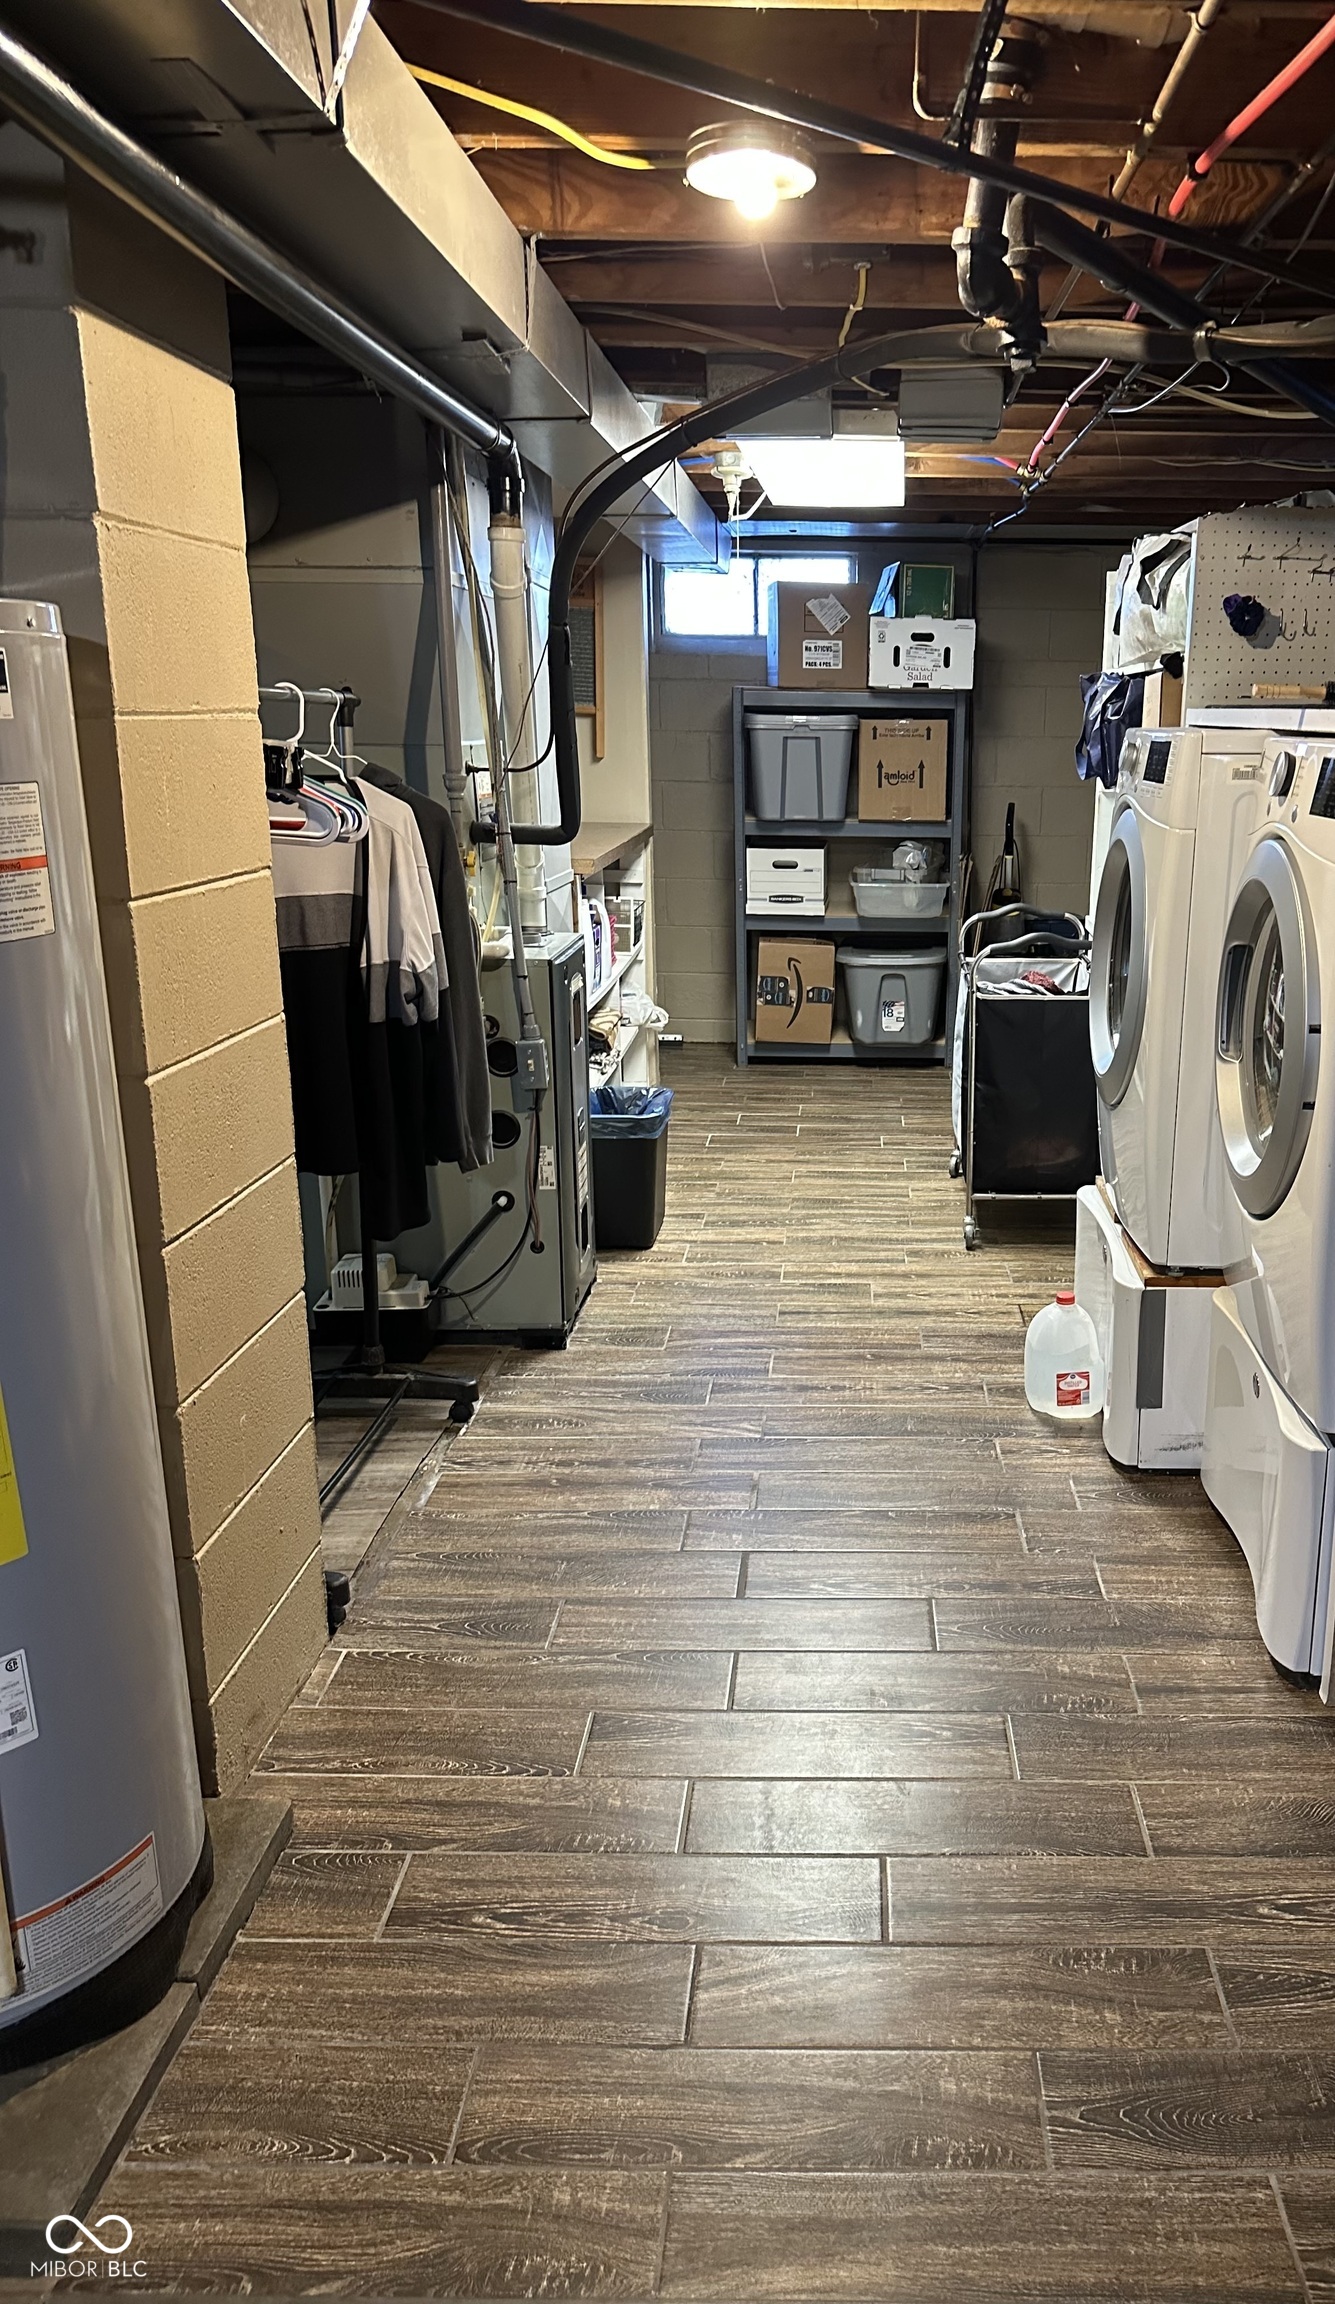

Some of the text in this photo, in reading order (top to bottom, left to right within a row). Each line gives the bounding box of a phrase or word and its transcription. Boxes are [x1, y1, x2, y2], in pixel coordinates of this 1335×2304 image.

[907, 672, 933, 682] Salad
[883, 769, 916, 786] amloid
[883, 1006, 894, 1018] 18
